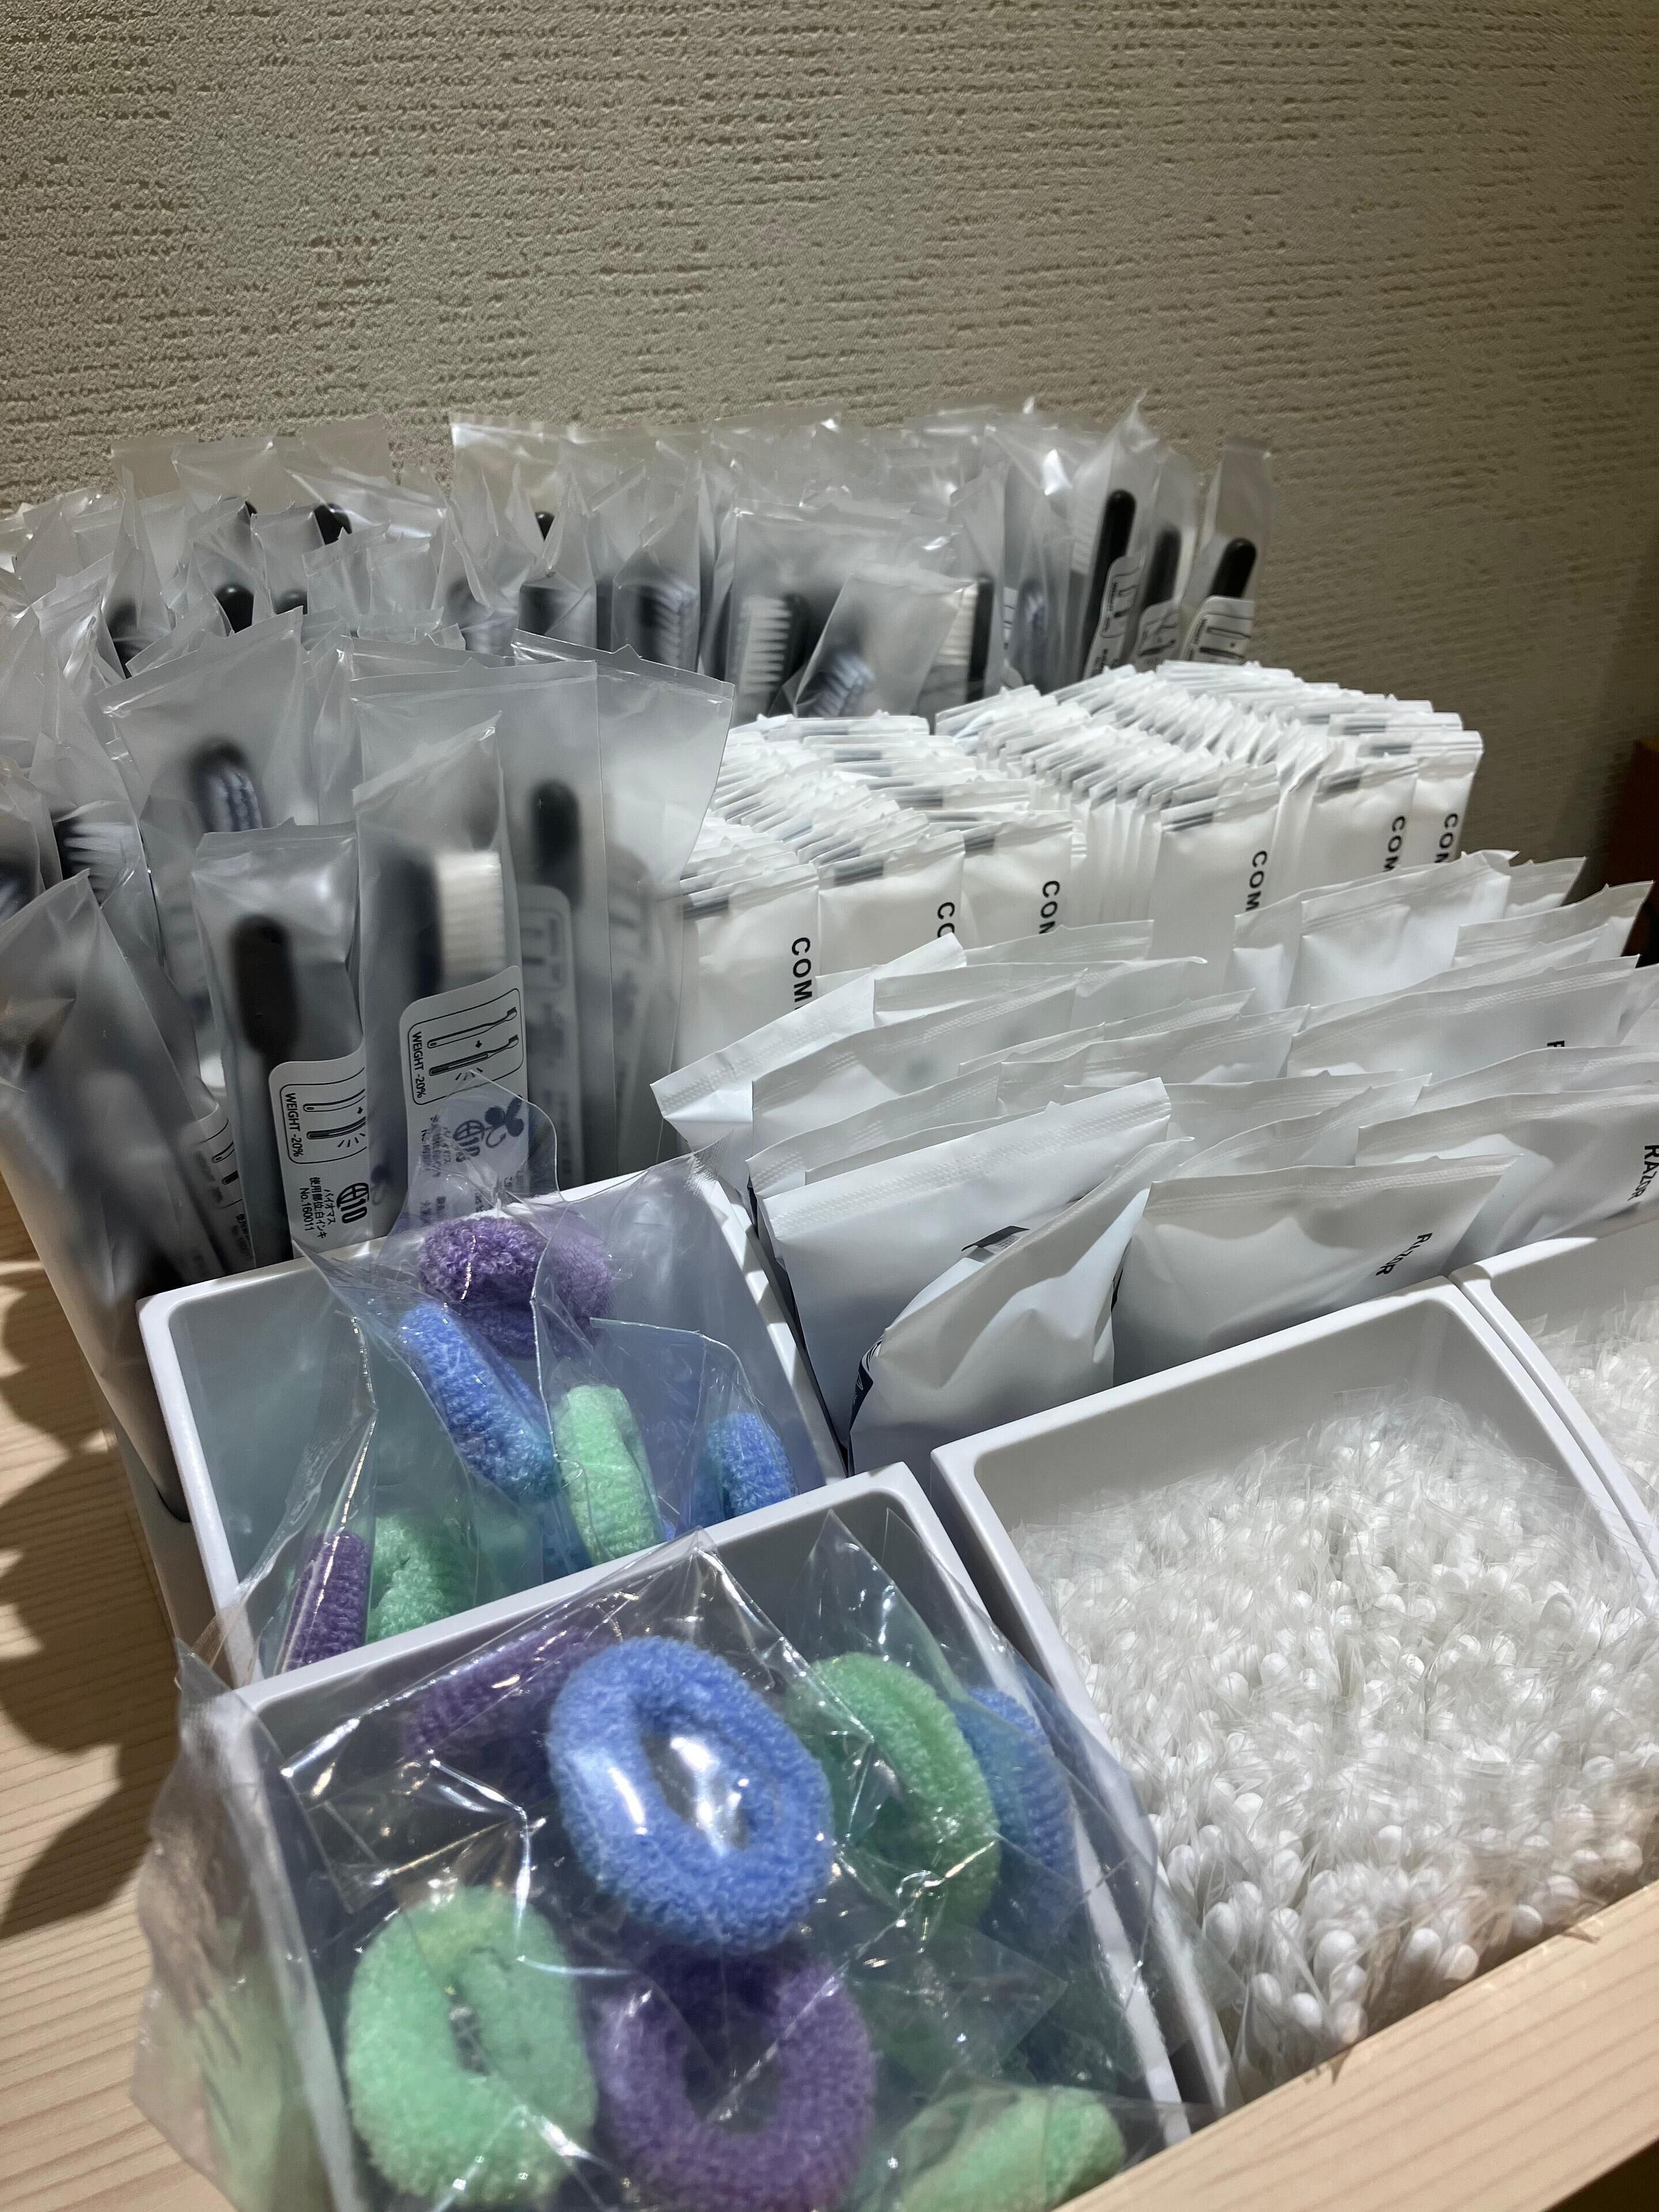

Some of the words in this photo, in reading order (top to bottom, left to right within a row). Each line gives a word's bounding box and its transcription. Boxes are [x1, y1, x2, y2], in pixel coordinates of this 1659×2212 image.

[1245, 851, 1267, 911] COM
[791, 937, 812, 1010] COM
[412, 1031, 424, 1070] WEIGHT
[417, 1073, 426, 1099] -20%
[285, 1093, 300, 1131] WEIGHT
[291, 1134, 304, 1157] -20%
[1627, 1145, 1659, 1201] RAZOR
[300, 1187, 315, 1231] No.160011
[324, 1188, 336, 1225] バイオマス
[1375, 1232, 1433, 1276] RAZOR
